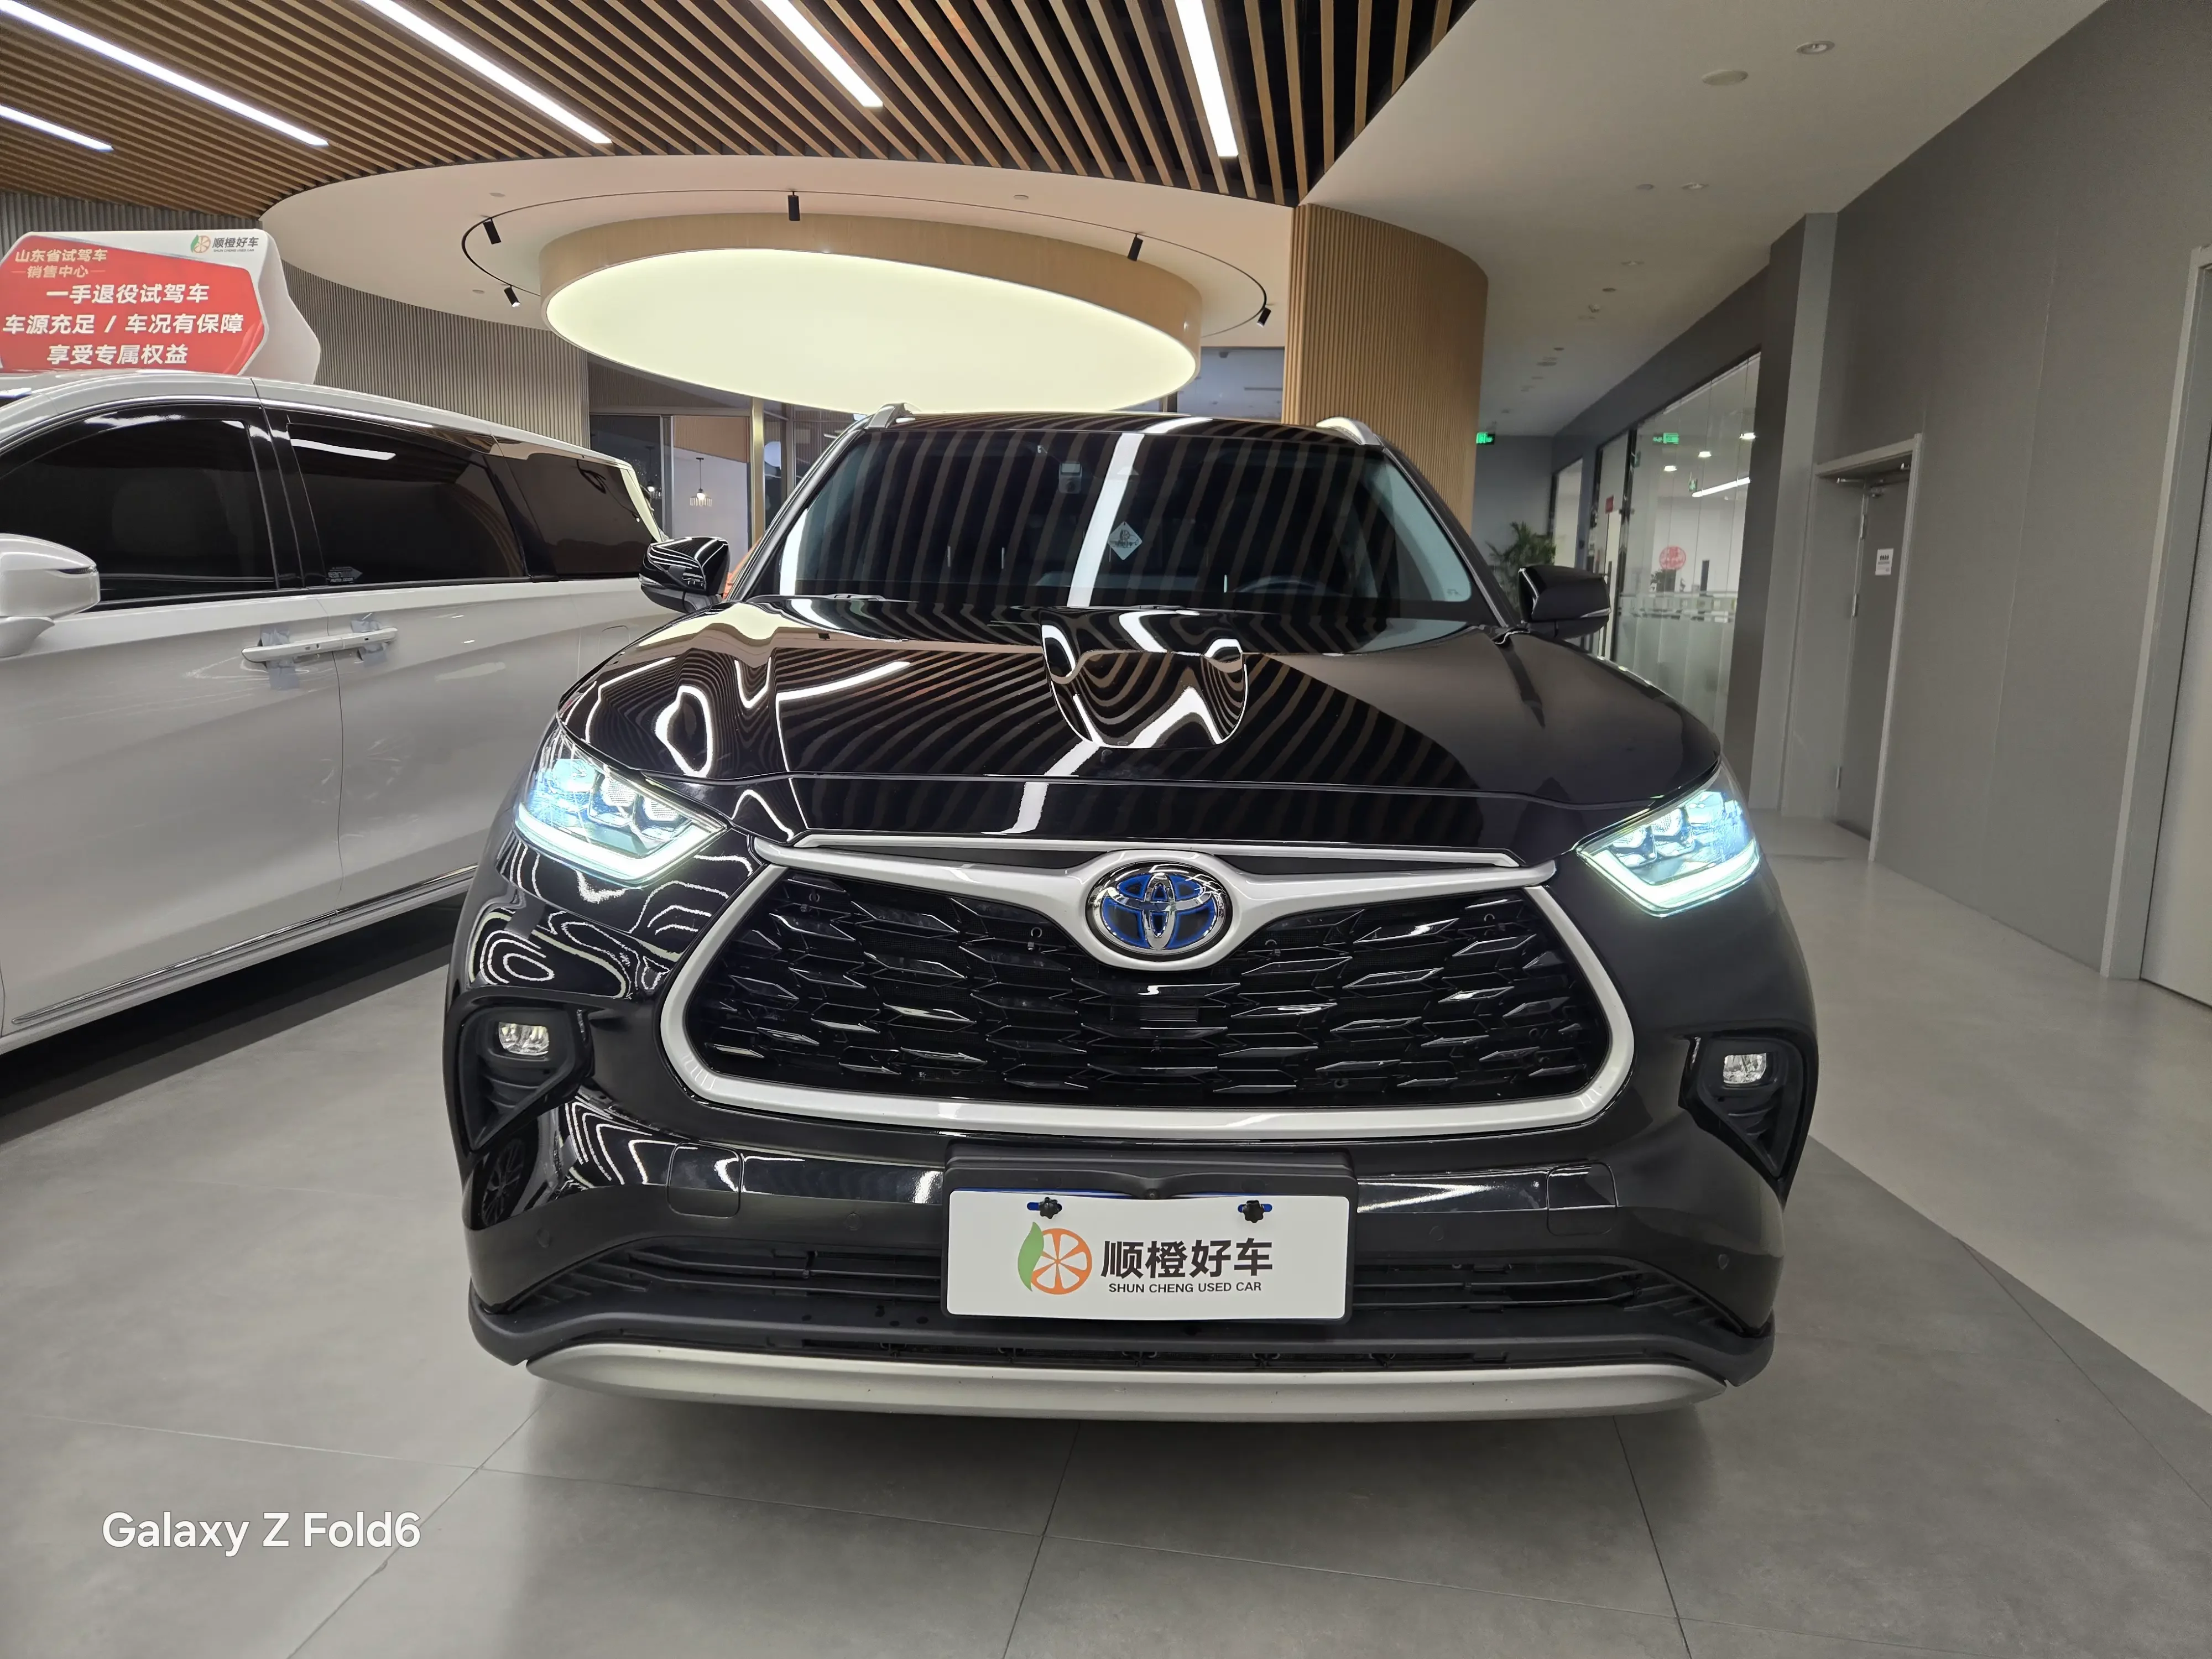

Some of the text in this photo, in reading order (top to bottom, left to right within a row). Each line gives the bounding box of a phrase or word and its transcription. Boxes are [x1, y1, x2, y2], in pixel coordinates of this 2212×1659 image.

[212, 237, 259, 248] 顺橙好车
[15, 249, 108, 262] 山东省试驾车
[27, 265, 88, 279] 销售中心
[46, 283, 210, 304] 一手退役试驾车
[3, 314, 95, 334] 车源充足
[125, 313, 244, 333] 车况有保障
[47, 344, 188, 365] 享受专属权益
[1100, 1238, 1272, 1279] 顺橙好车
[1109, 1281, 1261, 1293] SHUN CHENG USED CAR
